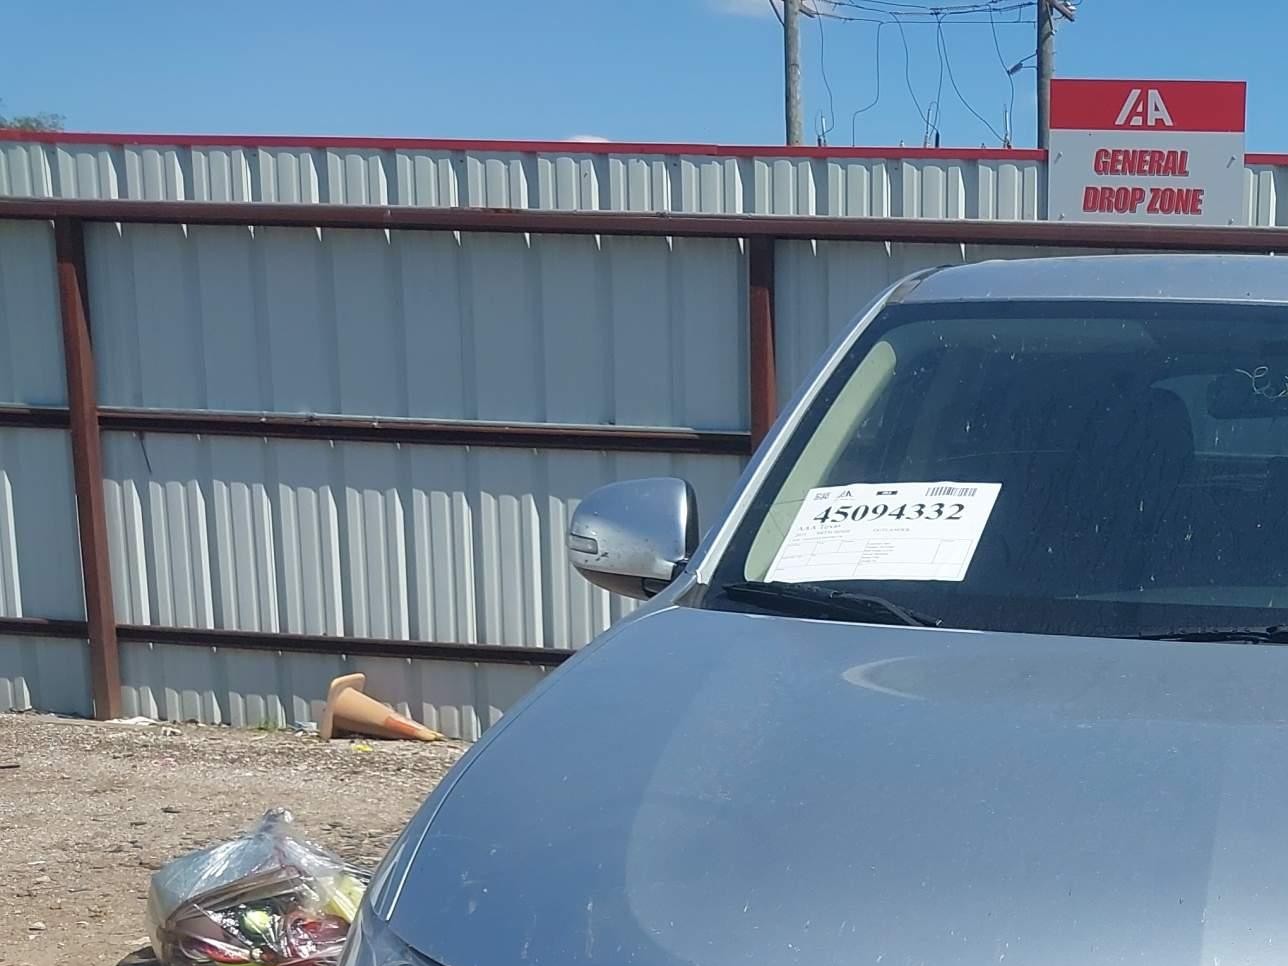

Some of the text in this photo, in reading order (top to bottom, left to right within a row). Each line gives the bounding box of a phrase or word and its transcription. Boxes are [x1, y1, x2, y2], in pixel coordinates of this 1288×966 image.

[1094, 149, 1189, 176] GENERAL
[1082, 186, 1204, 215] DROP ZONE
[813, 503, 966, 523] 45094332
